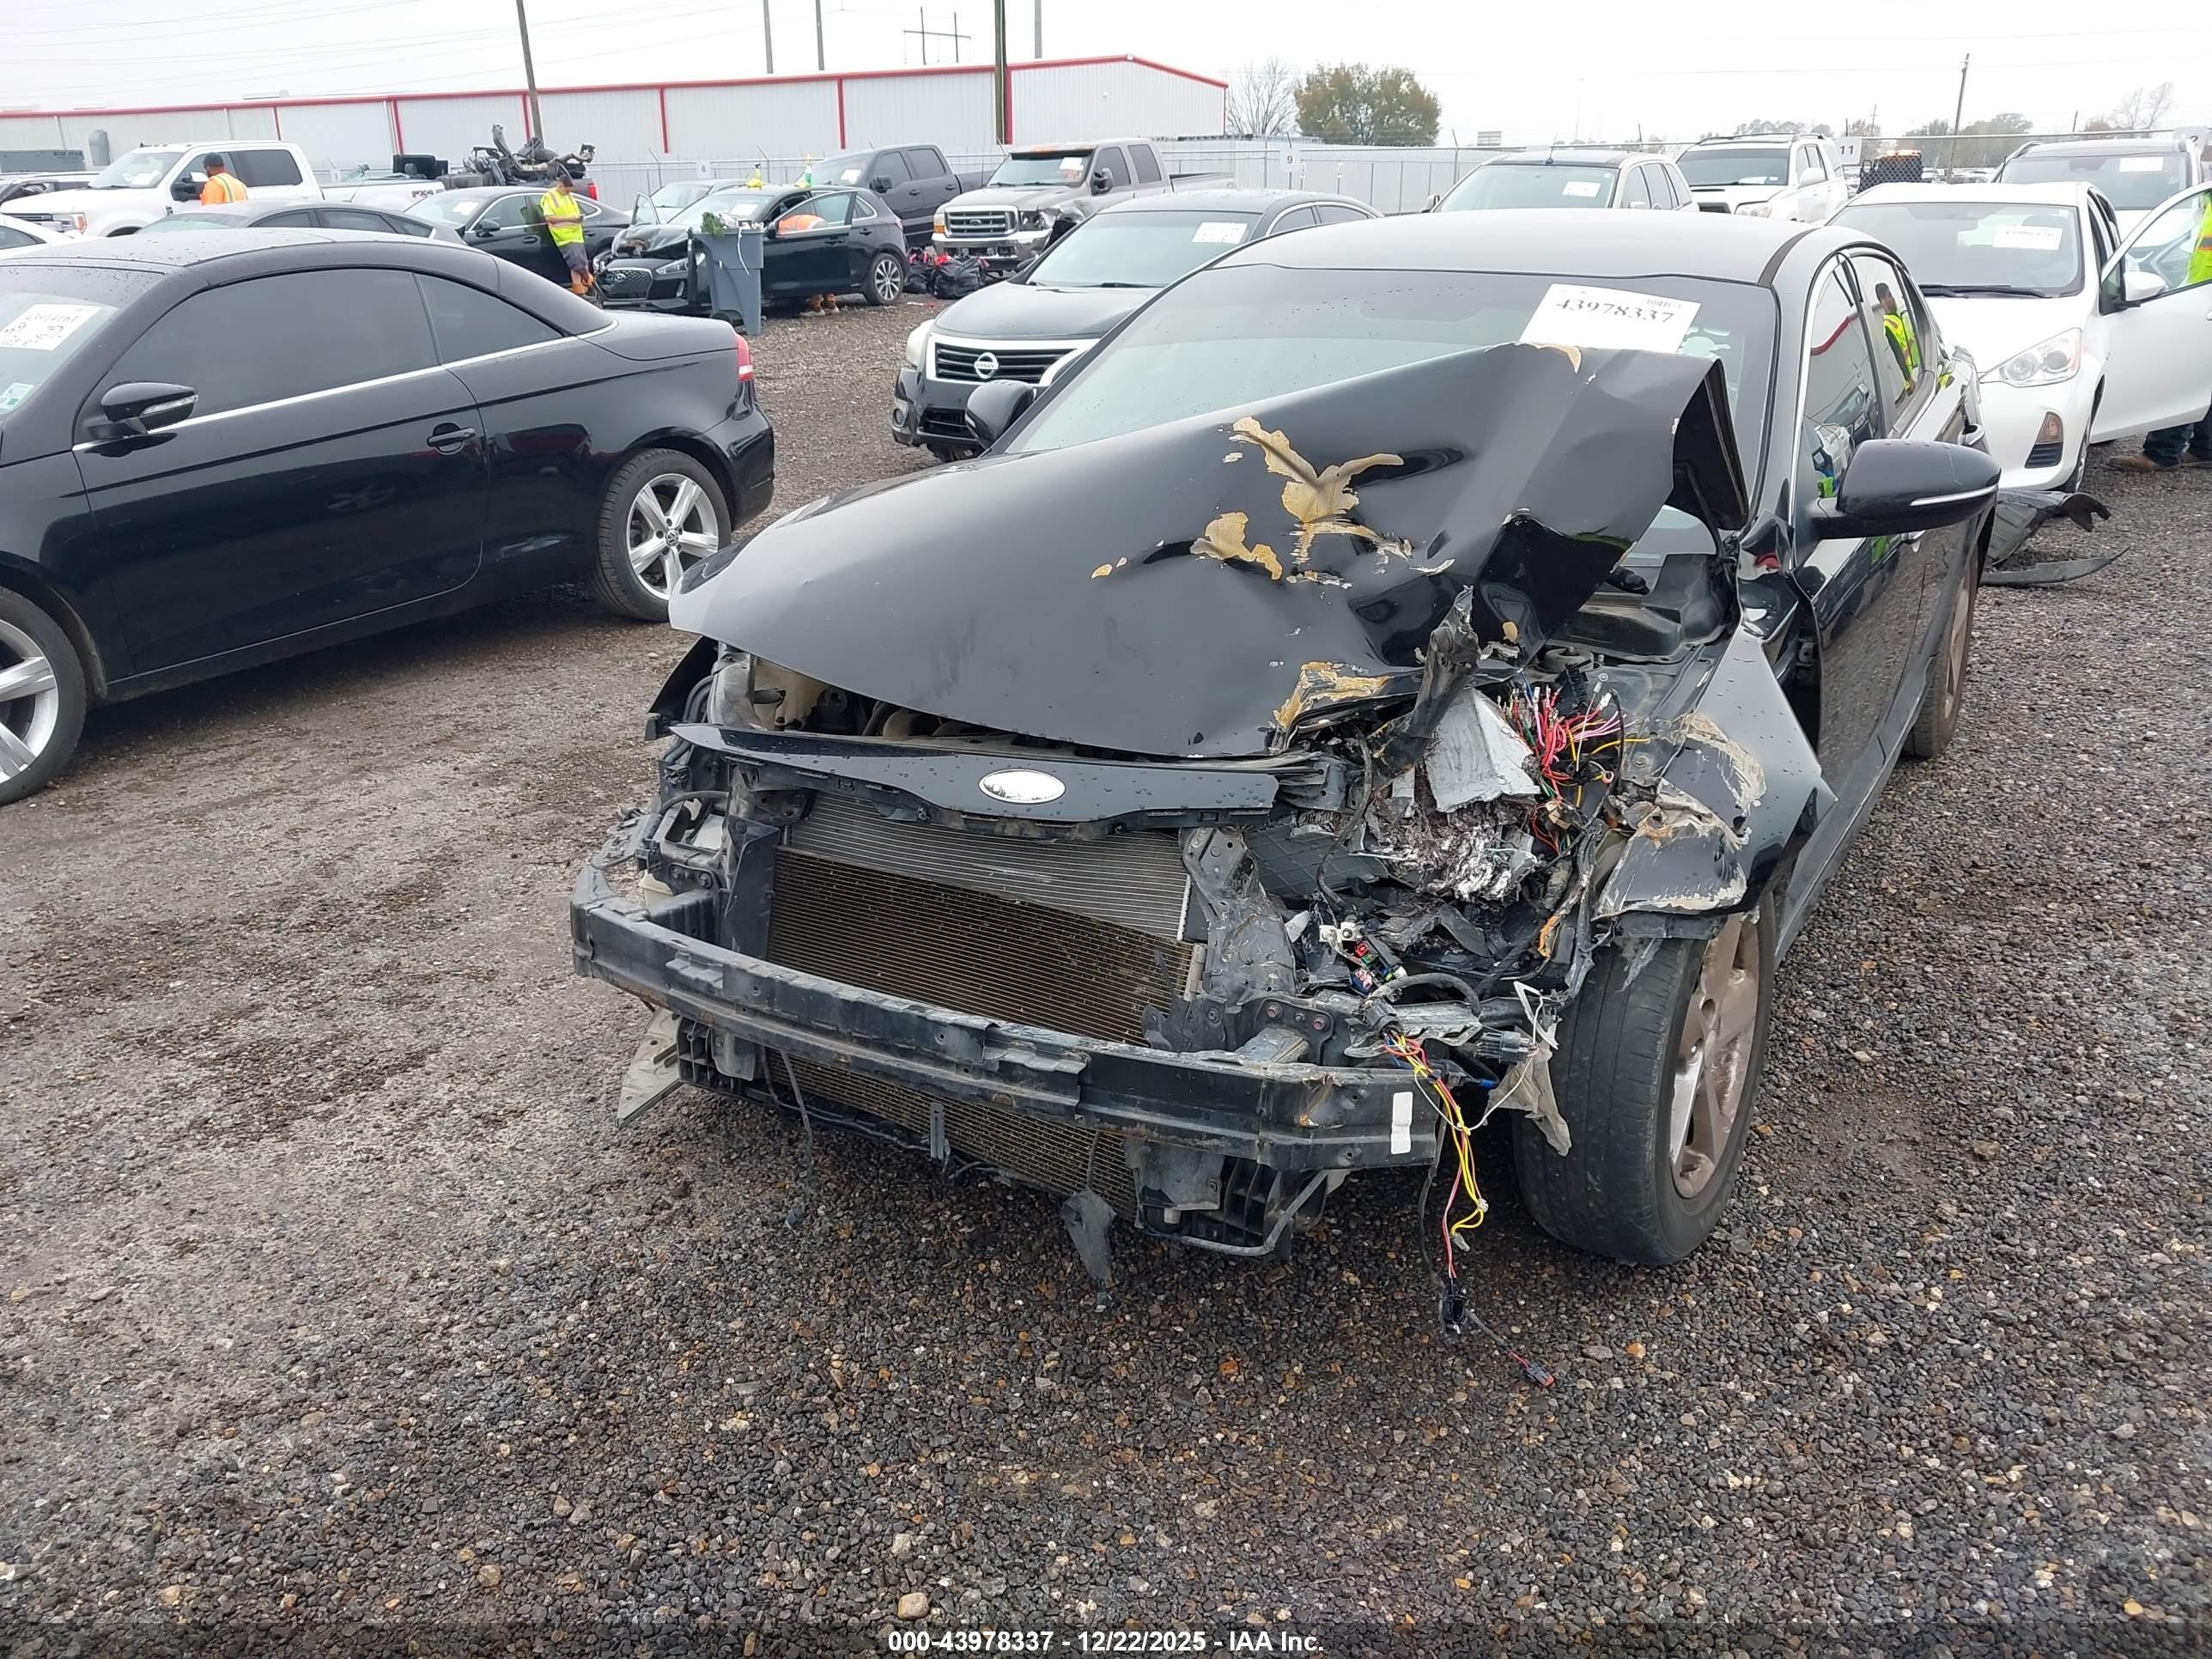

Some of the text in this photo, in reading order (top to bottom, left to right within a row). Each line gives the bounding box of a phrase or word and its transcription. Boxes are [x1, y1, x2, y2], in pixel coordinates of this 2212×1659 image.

[1839, 145, 1854, 155] 11
[1286, 155, 1293, 164] 9
[1556, 298, 1674, 323] 43978337
